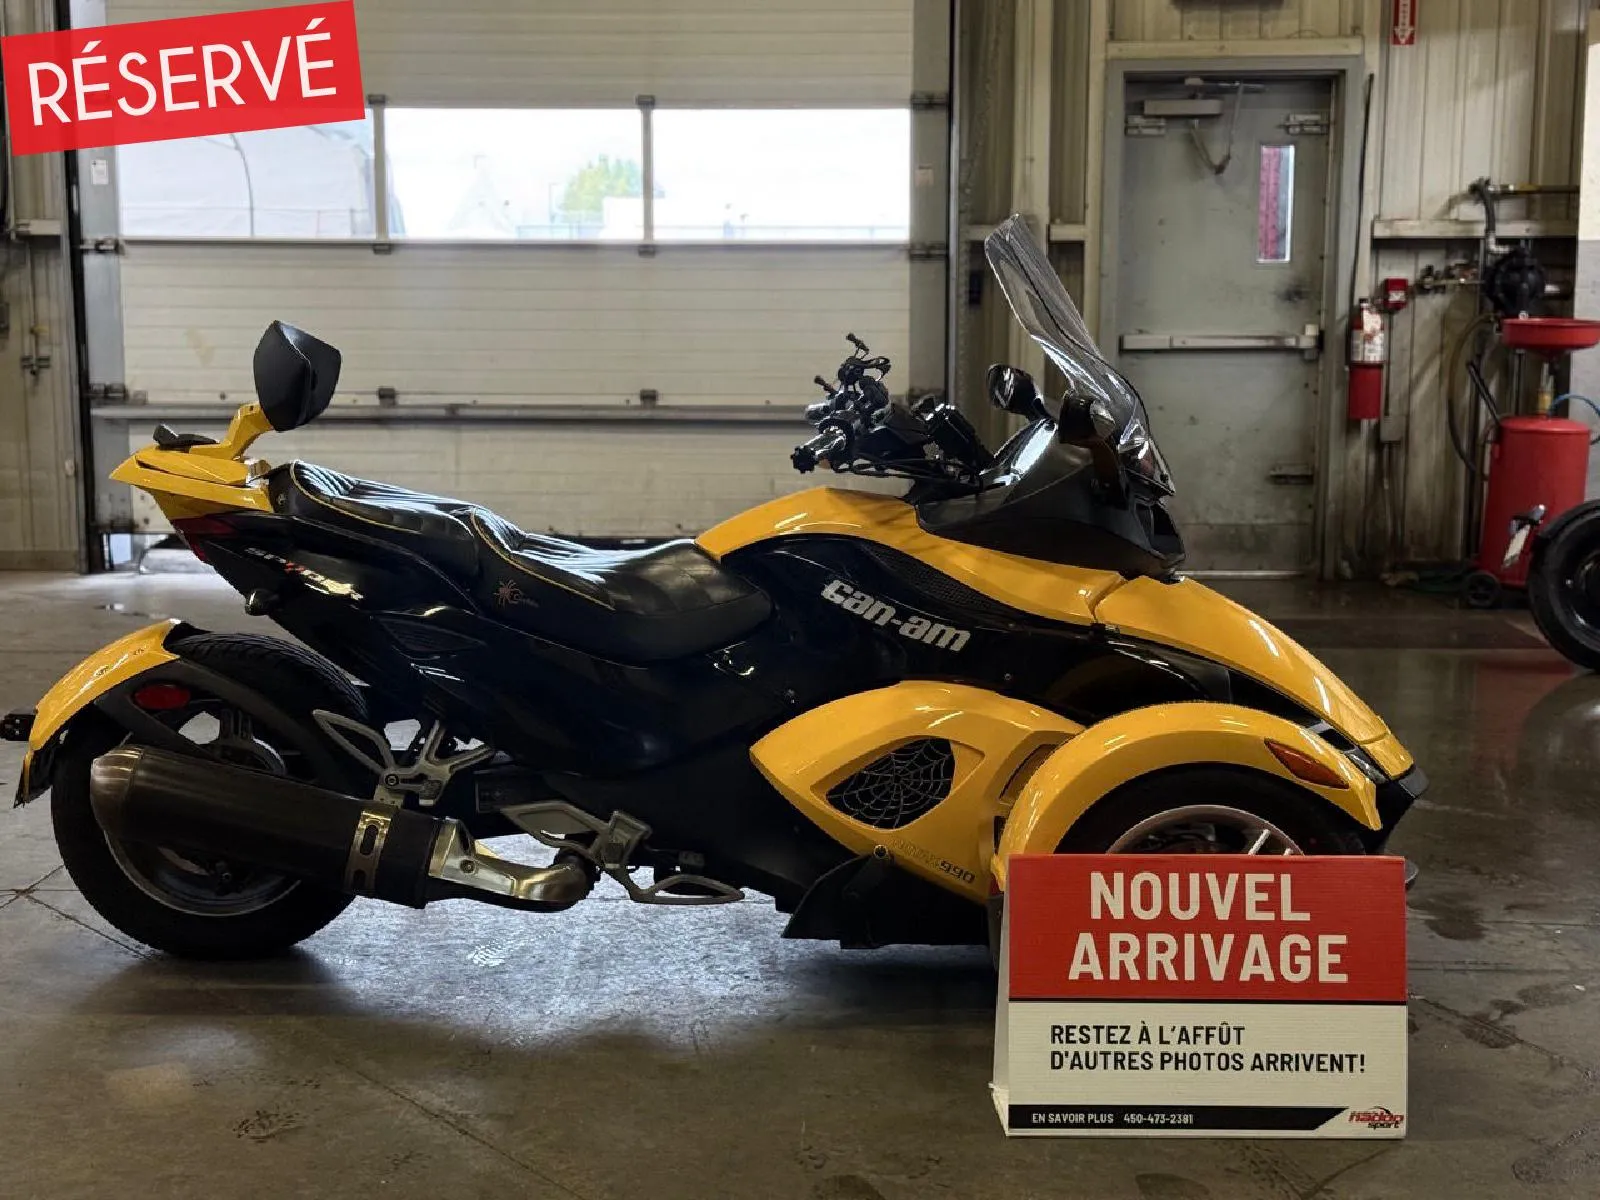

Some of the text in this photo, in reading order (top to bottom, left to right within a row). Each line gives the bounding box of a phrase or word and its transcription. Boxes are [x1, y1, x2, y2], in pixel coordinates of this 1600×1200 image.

[1090, 872, 1311, 922] NOUVEL
[1067, 932, 1349, 984] ARRIVAGE
[1050, 1024, 1131, 1045] RESTEZ
[1137, 1020, 1152, 1045] À
[1050, 1050, 1366, 1074] D'AUTRES PHOTOS ARRIVENT!
[1032, 1113, 1194, 1125] EN SAVOIR PLUS 450-473-2381
